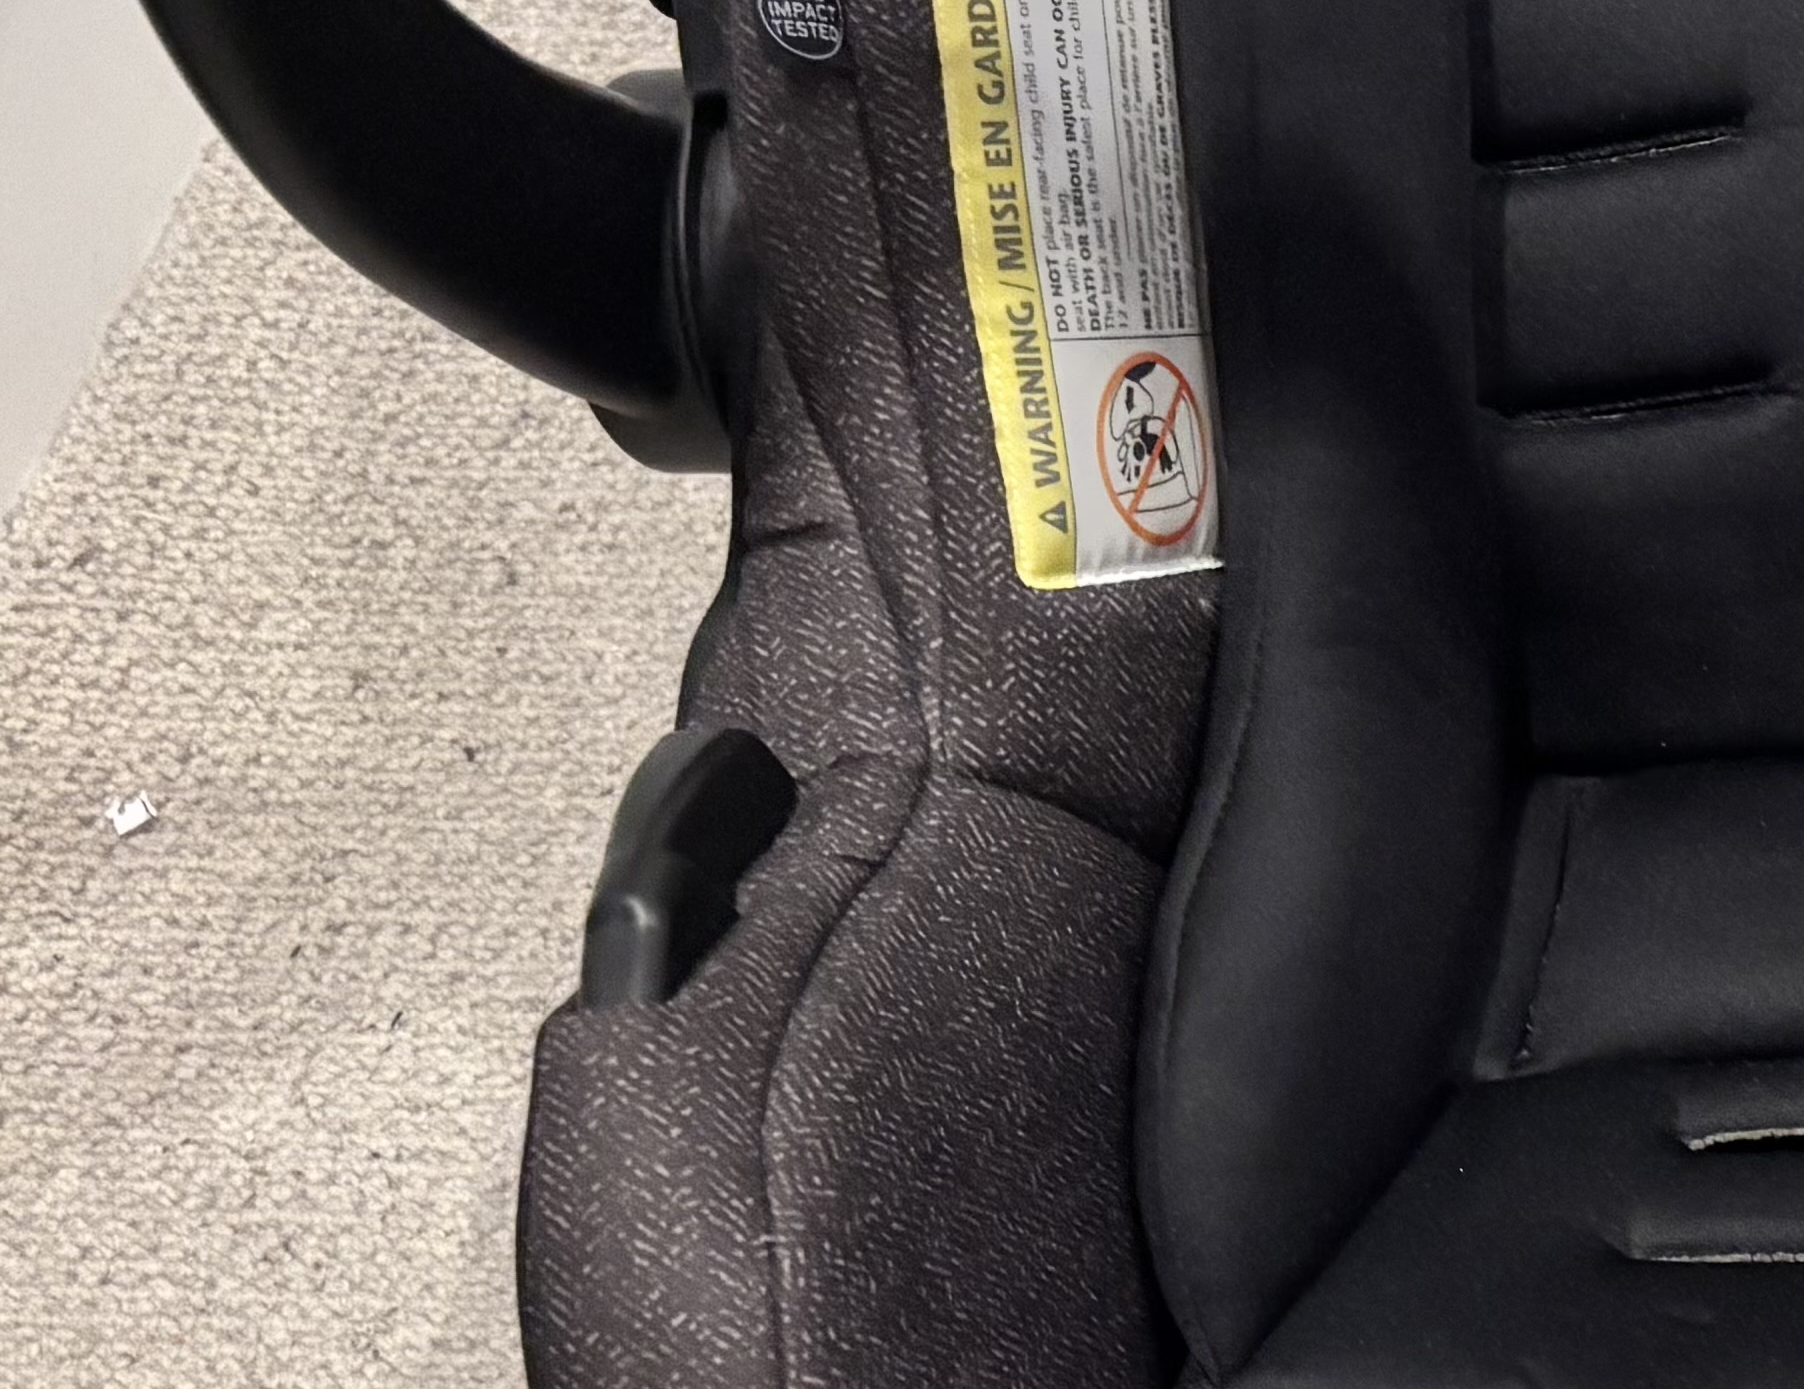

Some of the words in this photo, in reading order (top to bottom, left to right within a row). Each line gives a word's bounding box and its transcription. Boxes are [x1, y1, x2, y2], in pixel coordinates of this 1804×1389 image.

[767, 1, 836, 22] IMPACT
[771, 19, 840, 43] TESTED
[1020, 24, 1034, 56] seat
[1054, 29, 1068, 69] CAN
[1073, 37, 1084, 59] for
[1023, 63, 1039, 104] child
[1076, 65, 1092, 109] place
[1059, 77, 1077, 142] INJURY
[980, 120, 1013, 167] EN
[1030, 109, 1050, 200] rear-facing
[1067, 149, 1087, 227] SERIOUS
[1086, 168, 1098, 194] the
[988, 181, 1026, 271] MISE
[1042, 206, 1060, 251] place
[1062, 229, 1074, 251] air
[1078, 234, 1091, 261] OR
[1045, 256, 1063, 297] NOT
[1064, 257, 1080, 293] with
[1098, 256, 1112, 295] back
[1054, 304, 1069, 332] DO
[1071, 299, 1086, 332] seat
[1082, 268, 1102, 331] DEATH
[1104, 300, 1115, 330] The
[1006, 301, 1060, 488] WARNING
